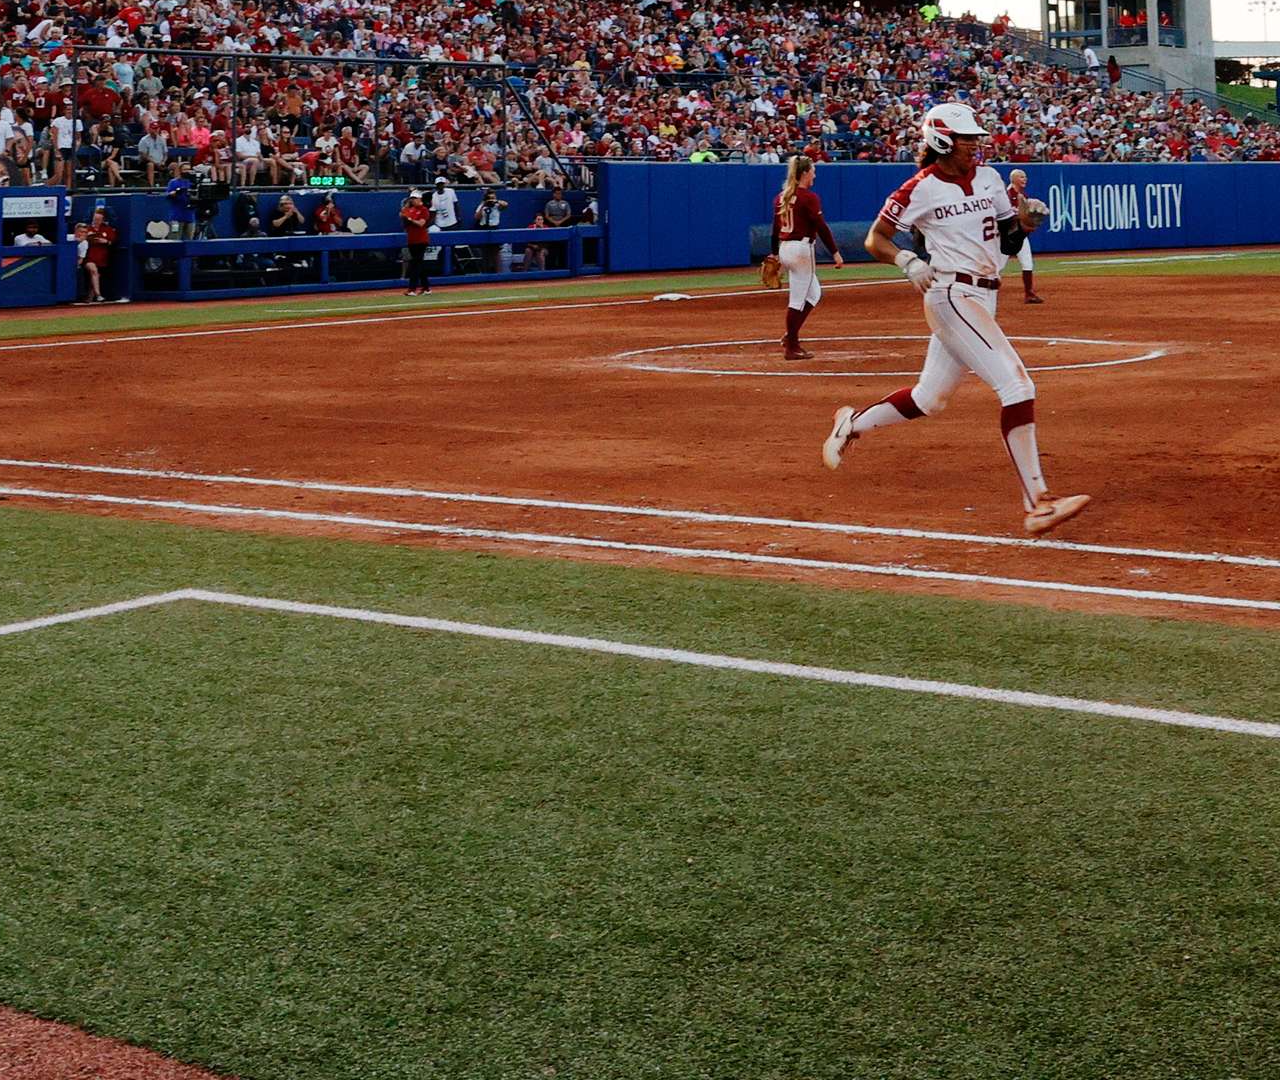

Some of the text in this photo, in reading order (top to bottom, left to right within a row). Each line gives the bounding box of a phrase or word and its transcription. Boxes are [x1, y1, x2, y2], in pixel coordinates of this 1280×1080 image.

[1048, 174, 1183, 232] OKLAHOMA CITY
[982, 216, 1000, 242] 2
